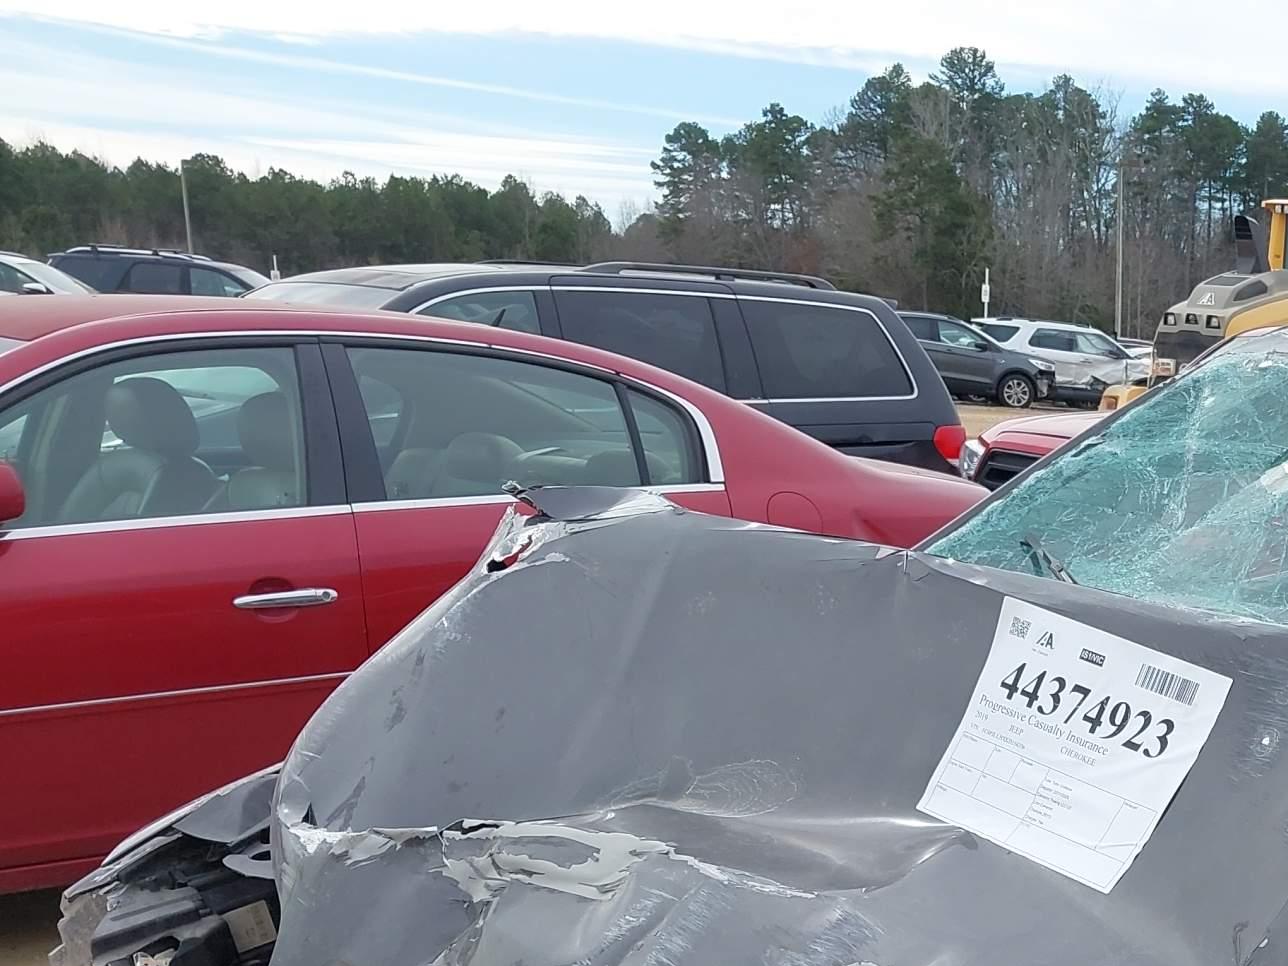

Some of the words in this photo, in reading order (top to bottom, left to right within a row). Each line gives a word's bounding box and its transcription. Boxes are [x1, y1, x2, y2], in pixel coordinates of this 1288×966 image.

[979, 693, 1027, 723] Progressive
[1027, 714, 1065, 741] Casualty
[1065, 729, 1109, 757] Insurance
[1000, 662, 1176, 759] 44374923
[1060, 745, 1097, 768] CHEROKEE
